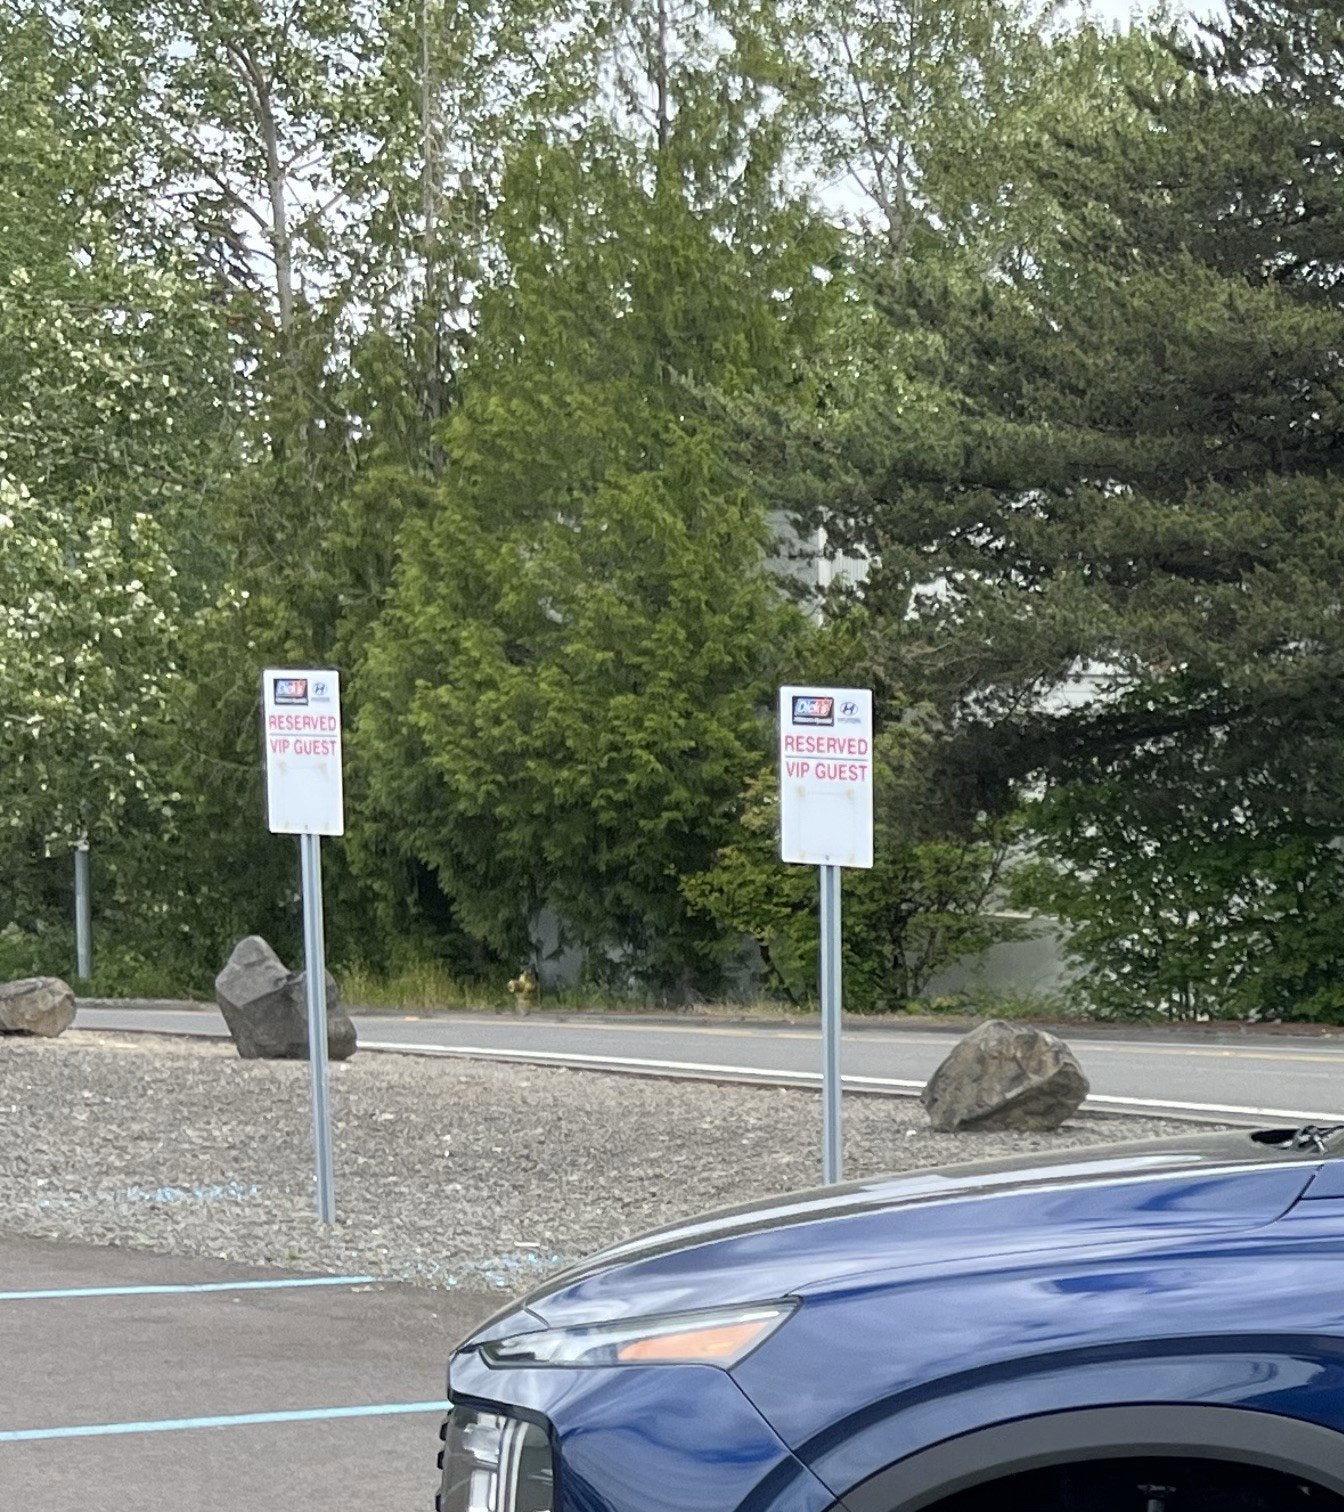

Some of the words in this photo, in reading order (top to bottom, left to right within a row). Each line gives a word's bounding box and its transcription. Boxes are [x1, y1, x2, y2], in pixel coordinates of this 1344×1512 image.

[268, 714, 337, 731] RESERVED
[269, 739, 290, 754] VIP
[293, 739, 337, 755] GUEST
[784, 735, 868, 755] RESERVED
[786, 761, 810, 778] VIP
[815, 762, 868, 781] GUEST
